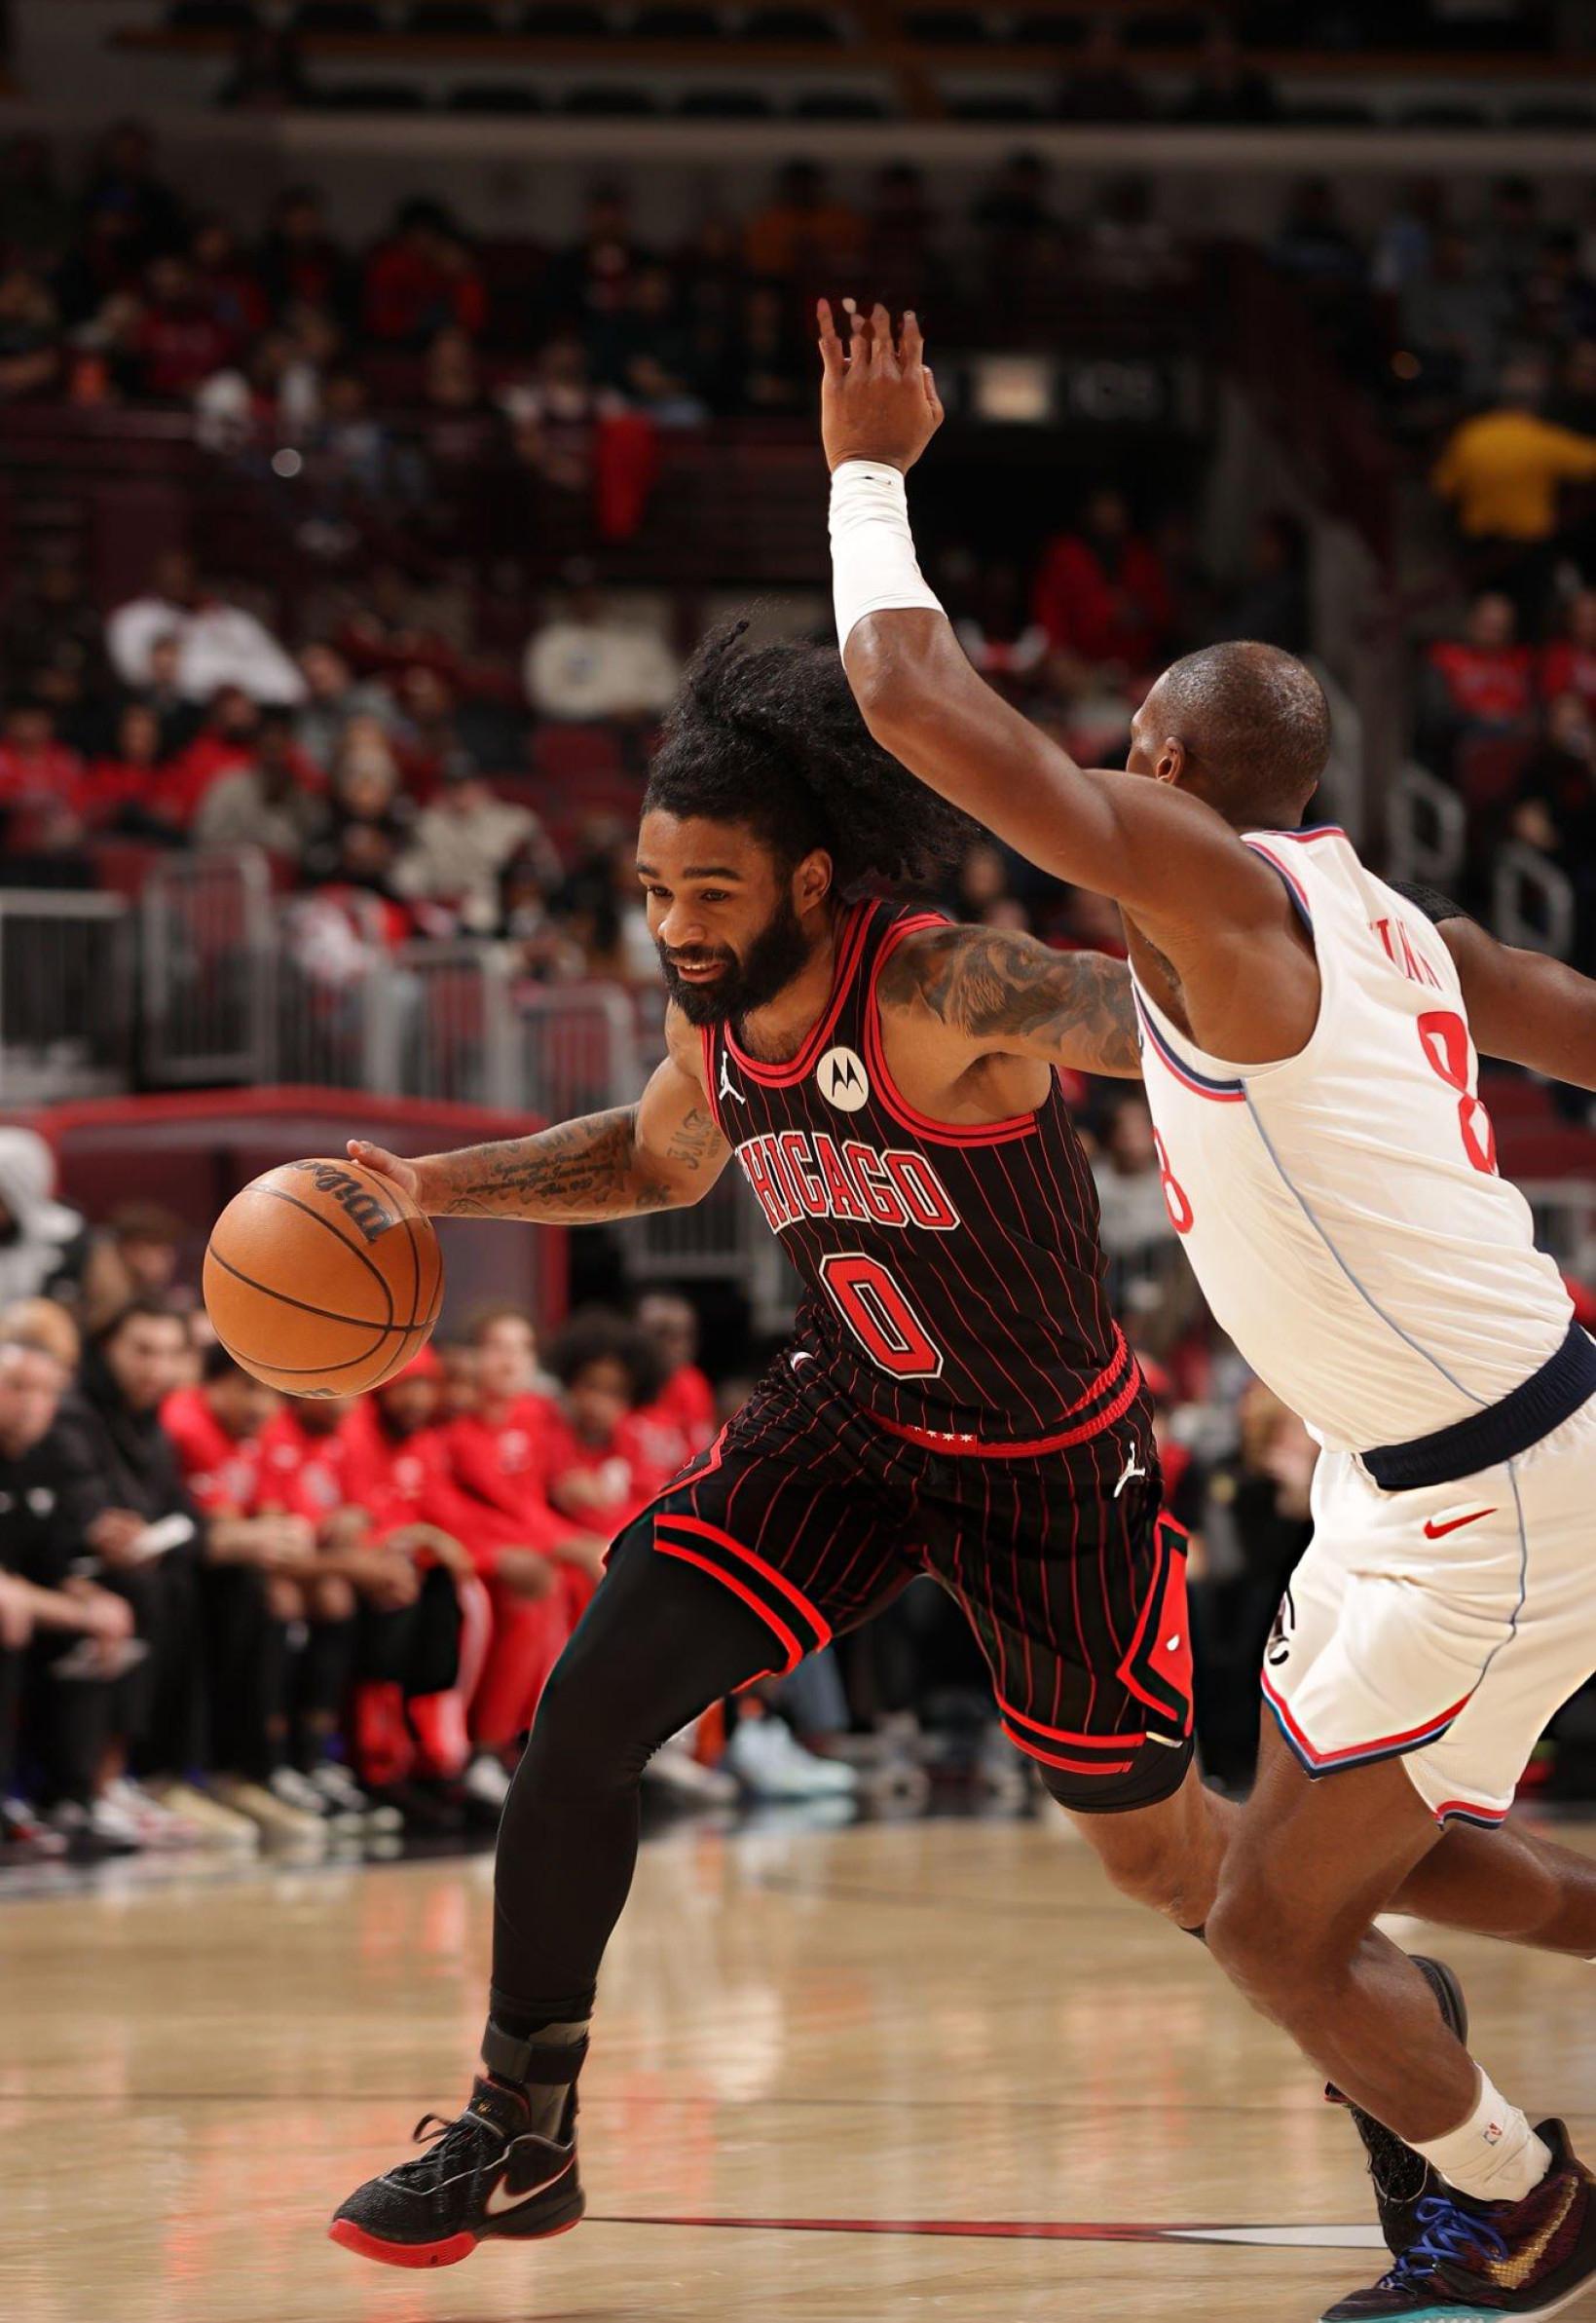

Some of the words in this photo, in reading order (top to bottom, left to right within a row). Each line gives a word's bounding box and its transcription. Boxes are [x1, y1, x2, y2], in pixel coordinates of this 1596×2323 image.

[1417, 1011, 1497, 1177] 8
[735, 1131, 961, 1234] HICAGO
[819, 1253, 944, 1380] 0
